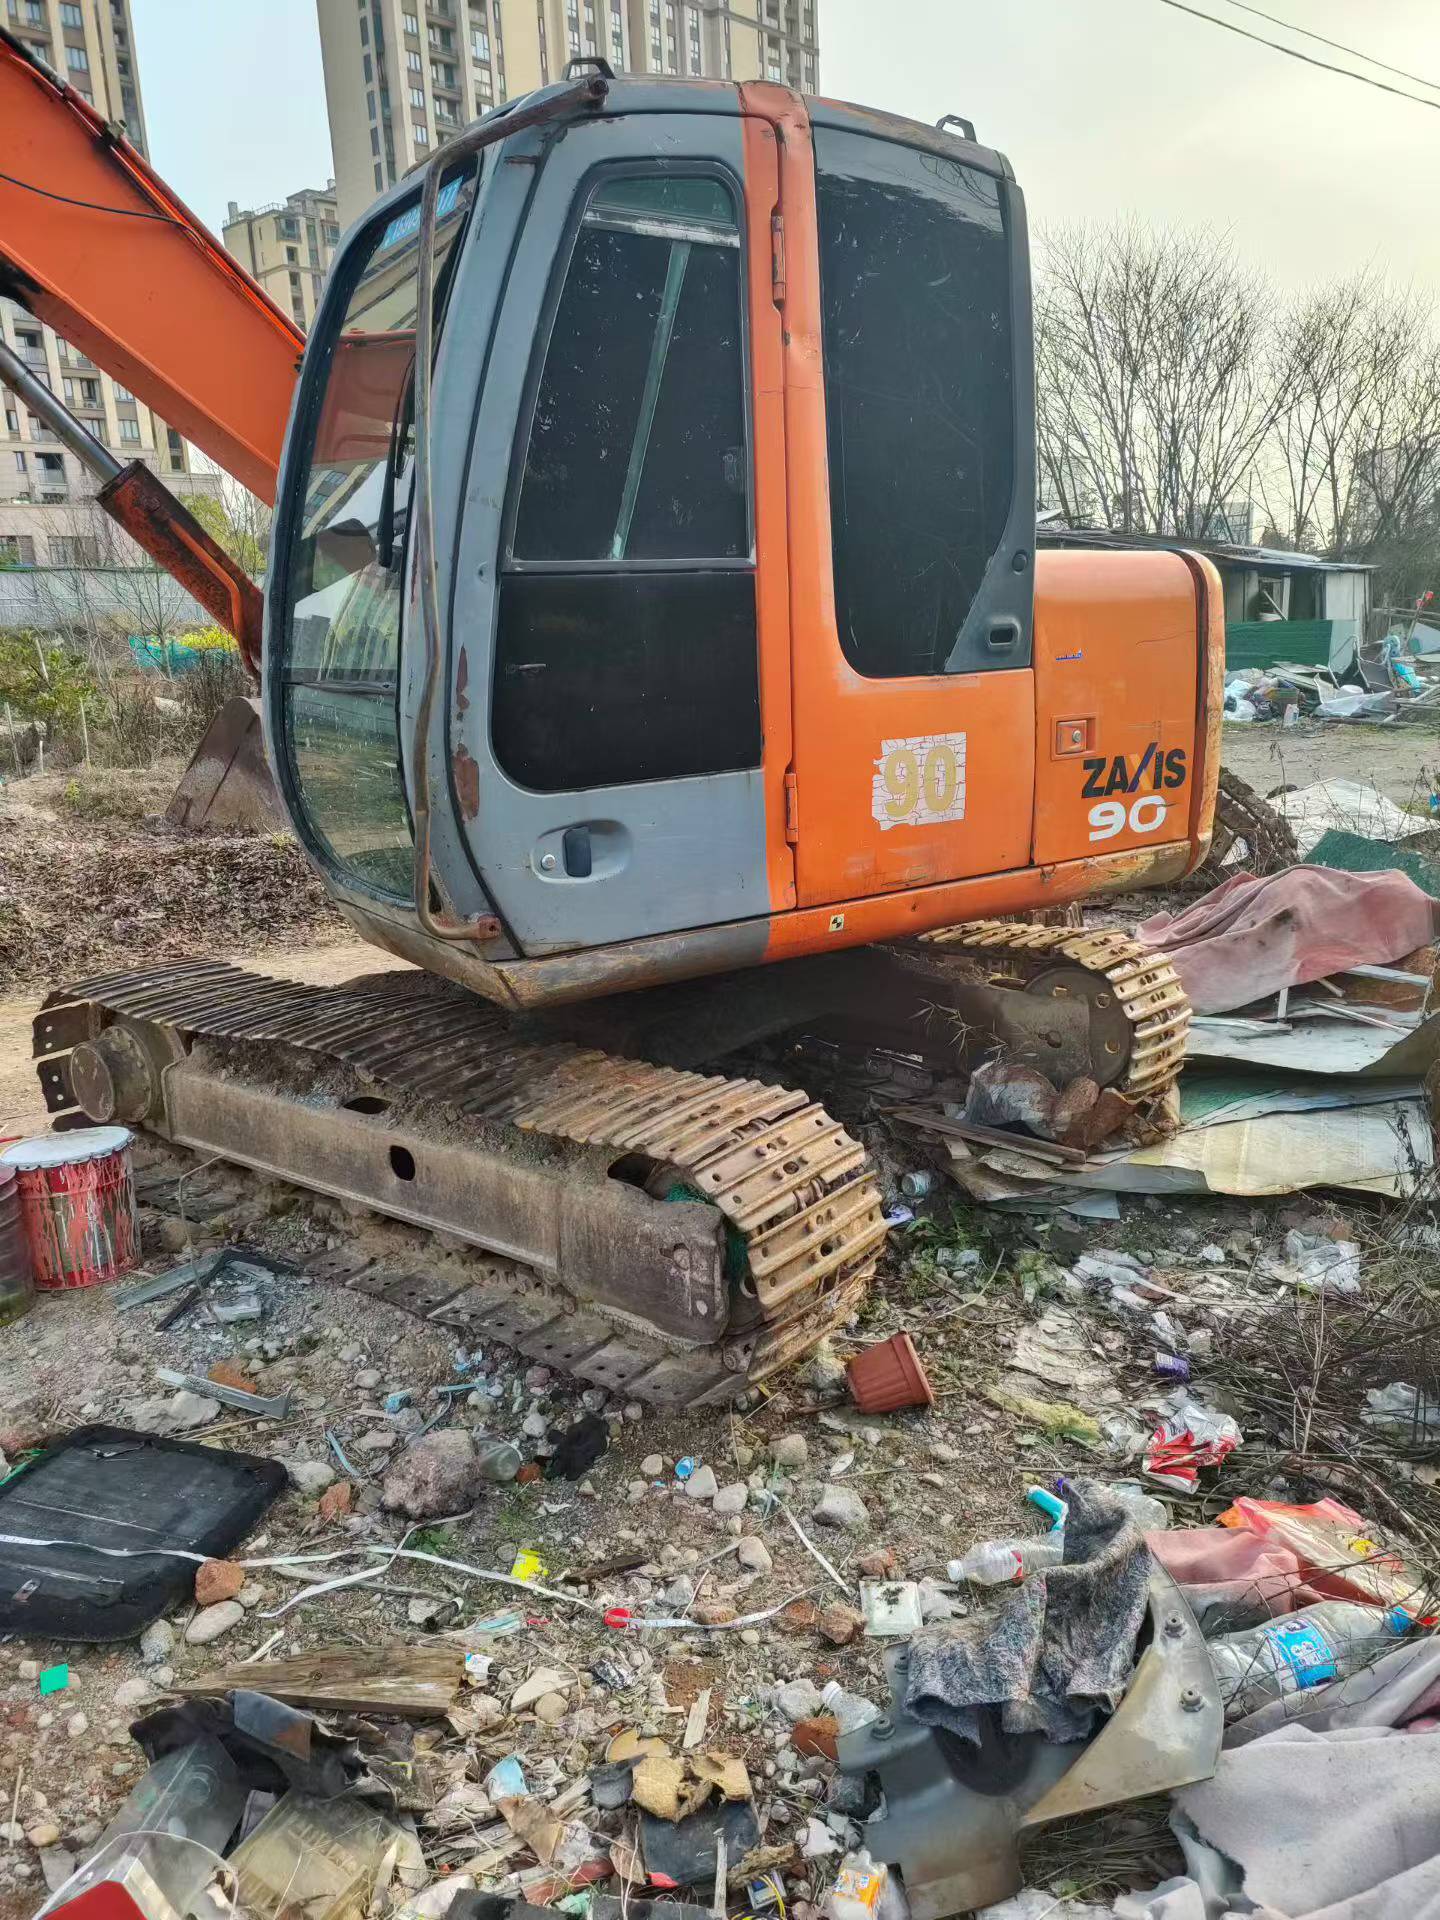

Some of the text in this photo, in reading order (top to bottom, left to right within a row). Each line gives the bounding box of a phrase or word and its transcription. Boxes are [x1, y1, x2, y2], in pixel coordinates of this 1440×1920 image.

[884, 745, 957, 817] 90
[1082, 742, 1187, 798] ZAXIS
[1088, 795, 1167, 841] 90
